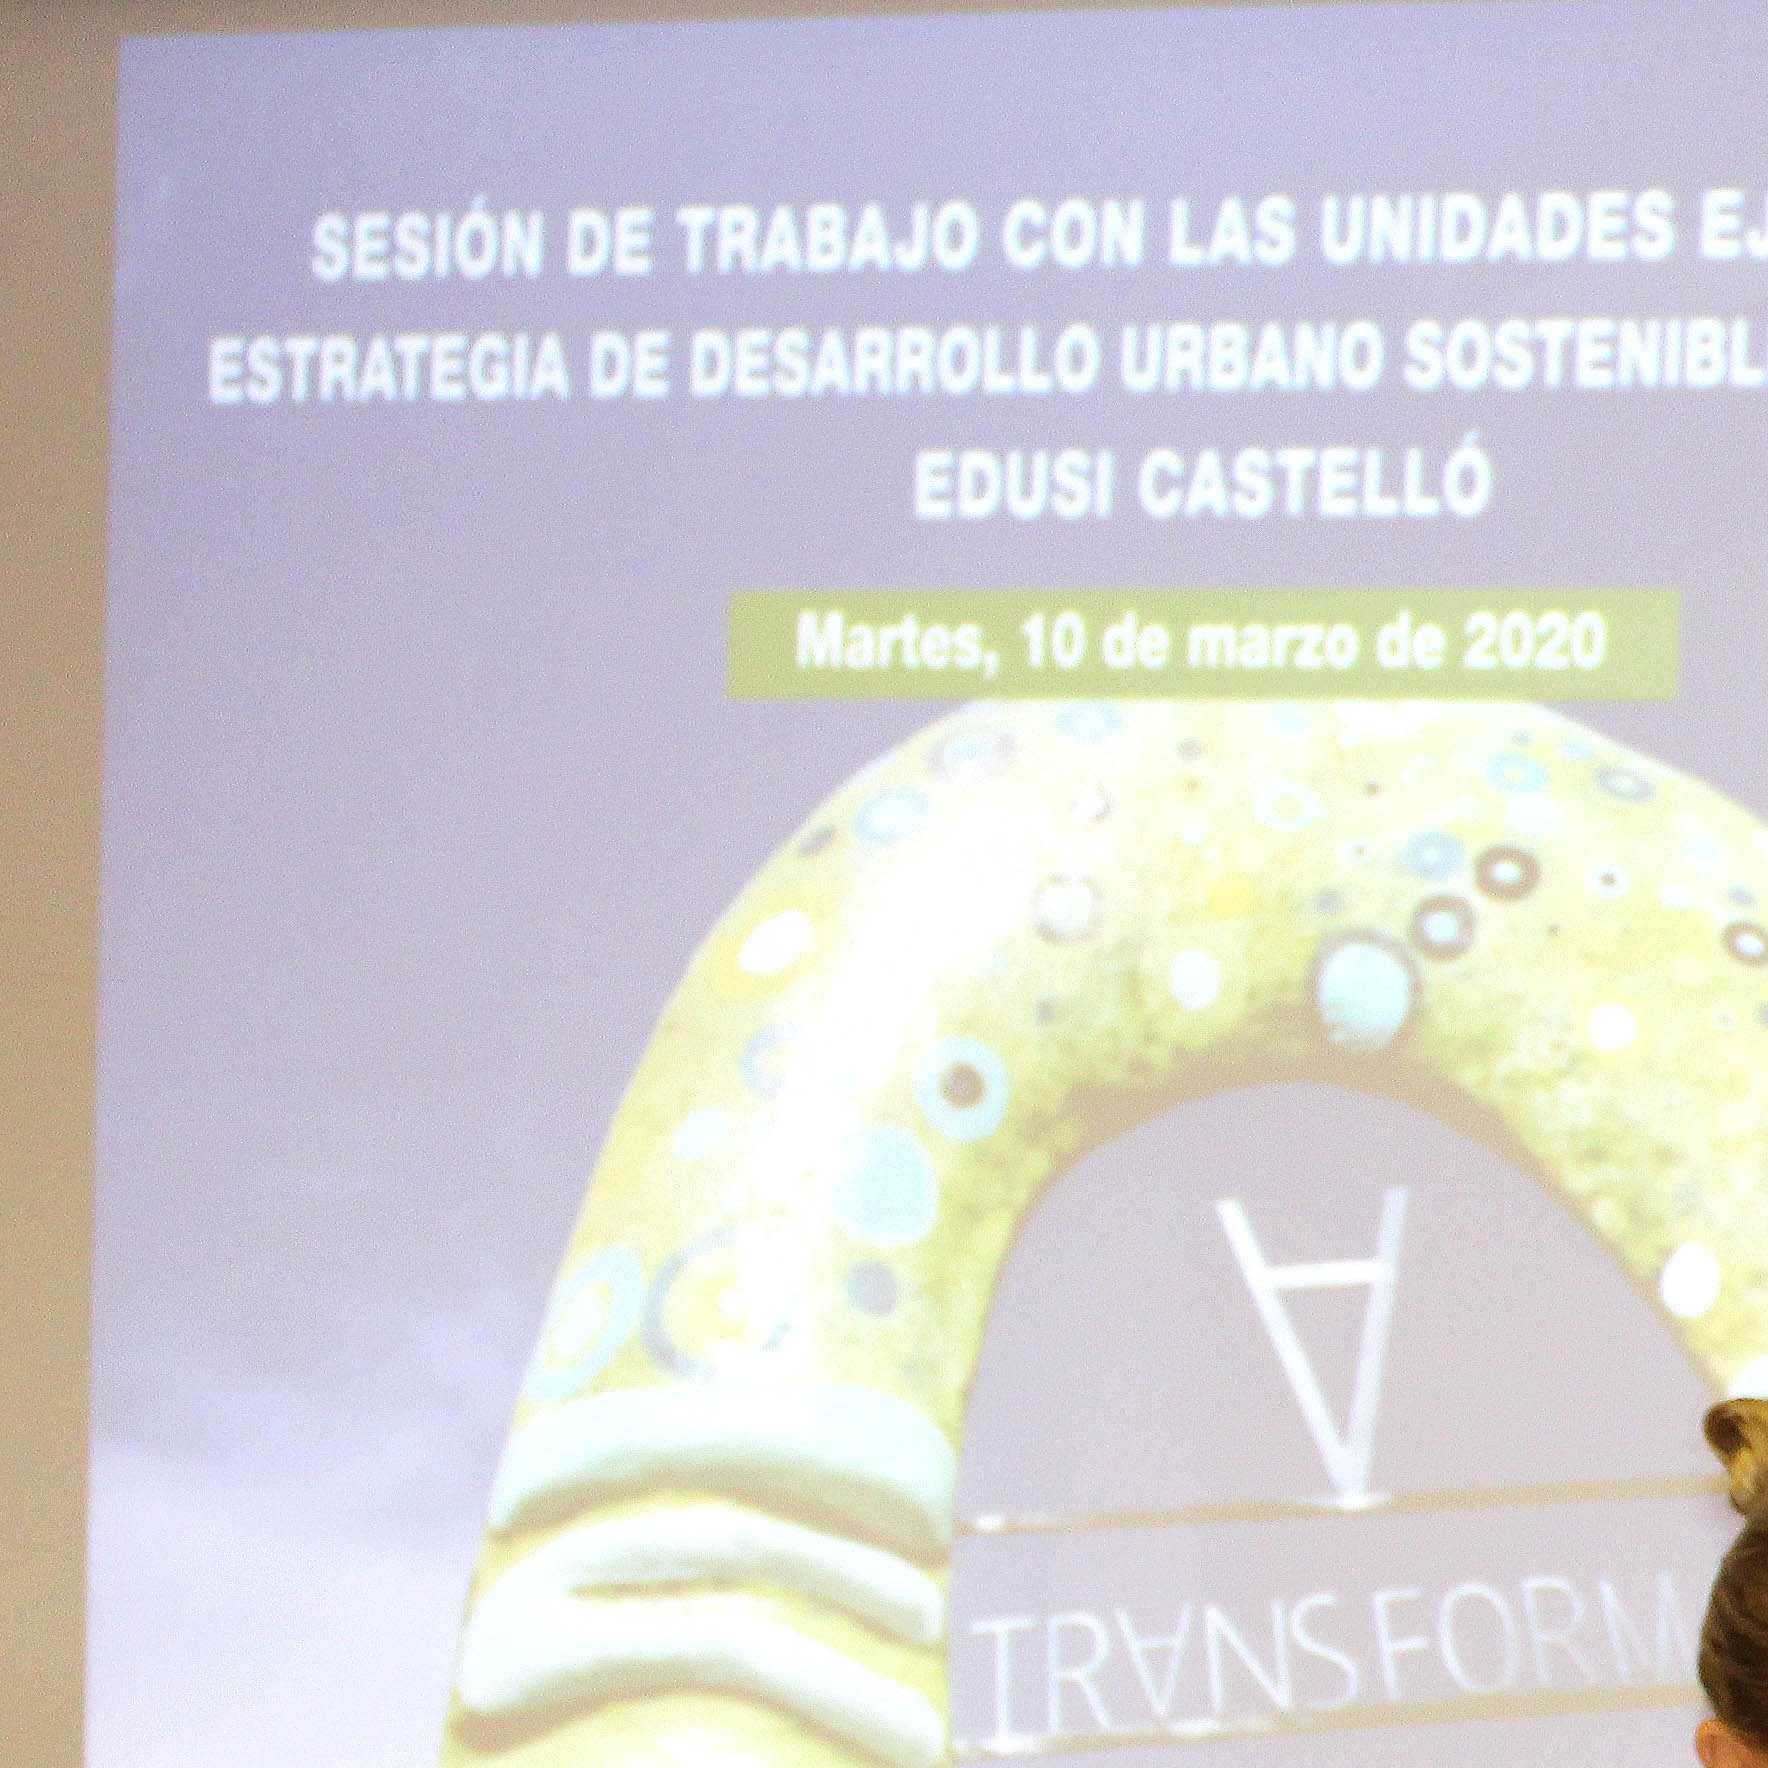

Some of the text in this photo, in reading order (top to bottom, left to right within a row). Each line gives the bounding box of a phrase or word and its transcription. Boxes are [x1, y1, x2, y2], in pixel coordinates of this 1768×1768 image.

[310, 196, 543, 283] SESIÓN
[566, 205, 652, 275] DE
[675, 199, 979, 272] TRABAJO
[1001, 197, 1144, 269] CON
[1169, 194, 1296, 266] LAS
[1320, 188, 1675, 263] UNIDADES
[207, 331, 569, 404] ESTRATEGIA
[589, 329, 670, 398] DE
[690, 323, 1099, 397] DESARROLLO
[1120, 319, 1384, 391] URBANO
[913, 430, 1492, 520] EDUSI CASTELLÓ
[796, 611, 1607, 678] Martes, 10 de marzo de 2020
[972, 1568, 1697, 1740] TRANSFORM
